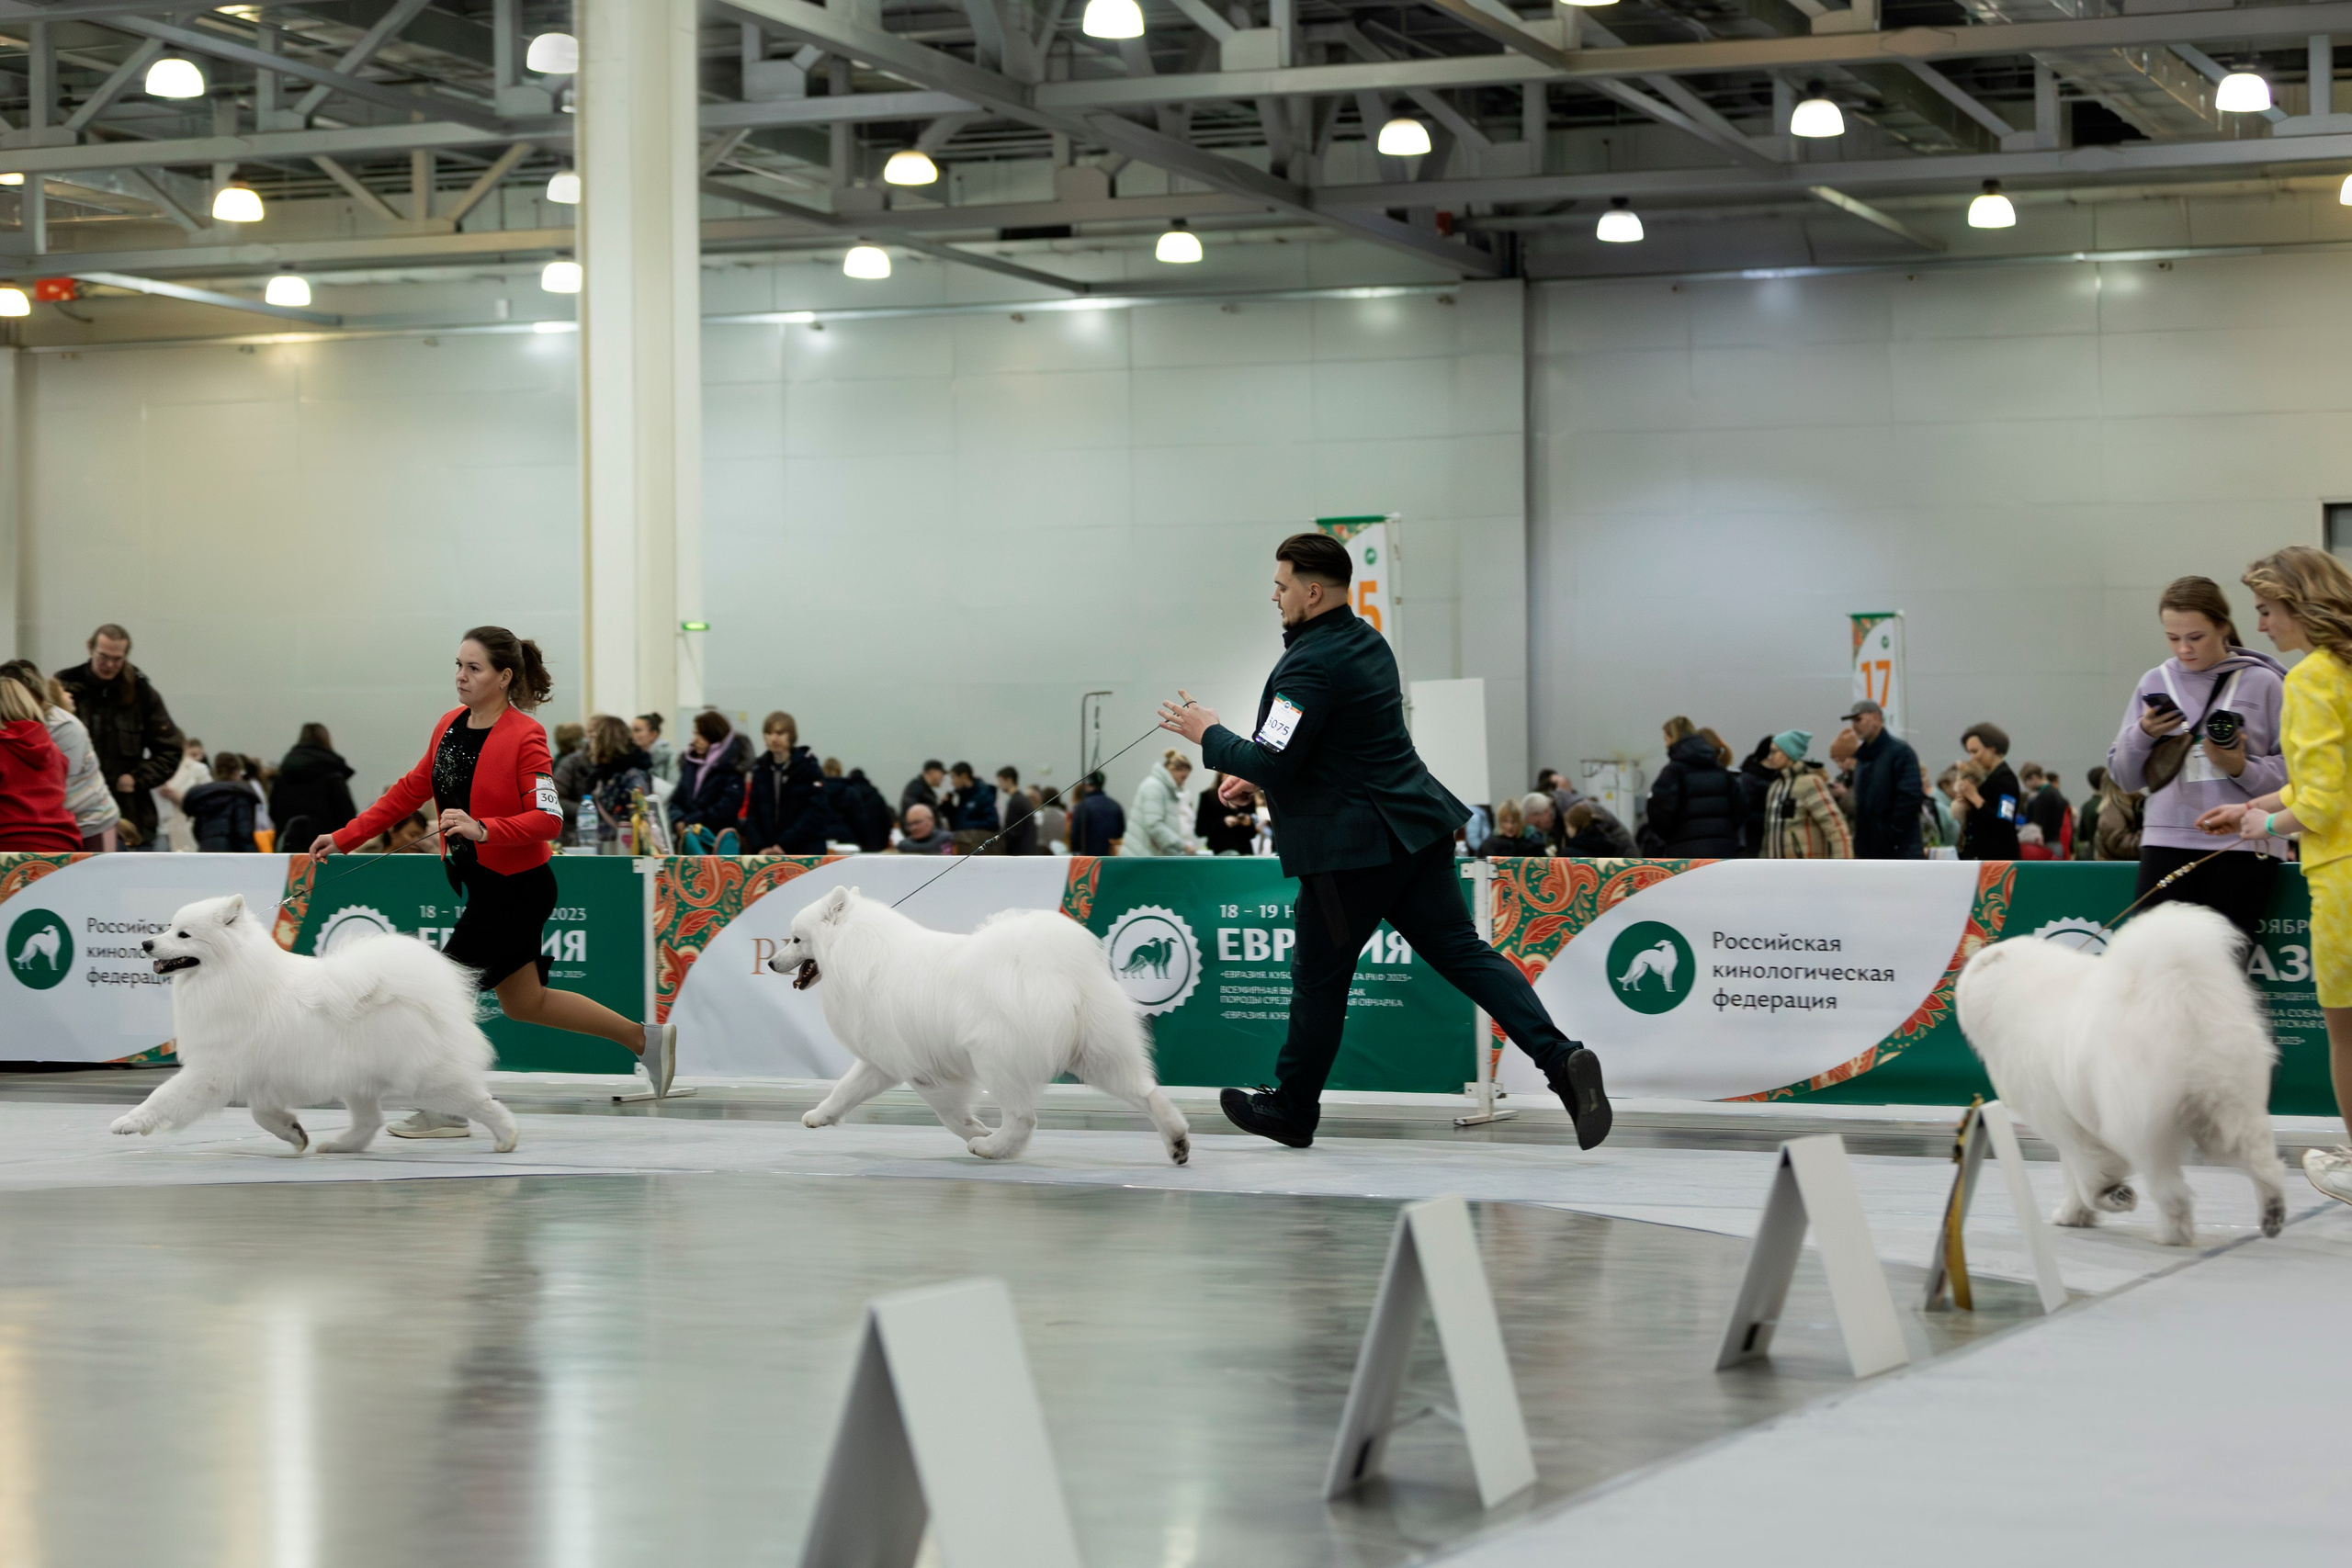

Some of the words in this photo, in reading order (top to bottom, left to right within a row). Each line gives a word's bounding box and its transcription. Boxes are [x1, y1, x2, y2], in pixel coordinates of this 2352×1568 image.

[1347, 581, 1383, 633] 5
[1860, 660, 1891, 708] 17
[419, 905, 437, 919] 18
[1218, 904, 1239, 919] 18
[1259, 904, 1279, 919] 19
[86, 917, 173, 934] Российск
[1713, 931, 1842, 953] Российская
[86, 966, 174, 988] федераци
[1713, 965, 1895, 983] кинологическая
[1713, 987, 1838, 1013] федерация
